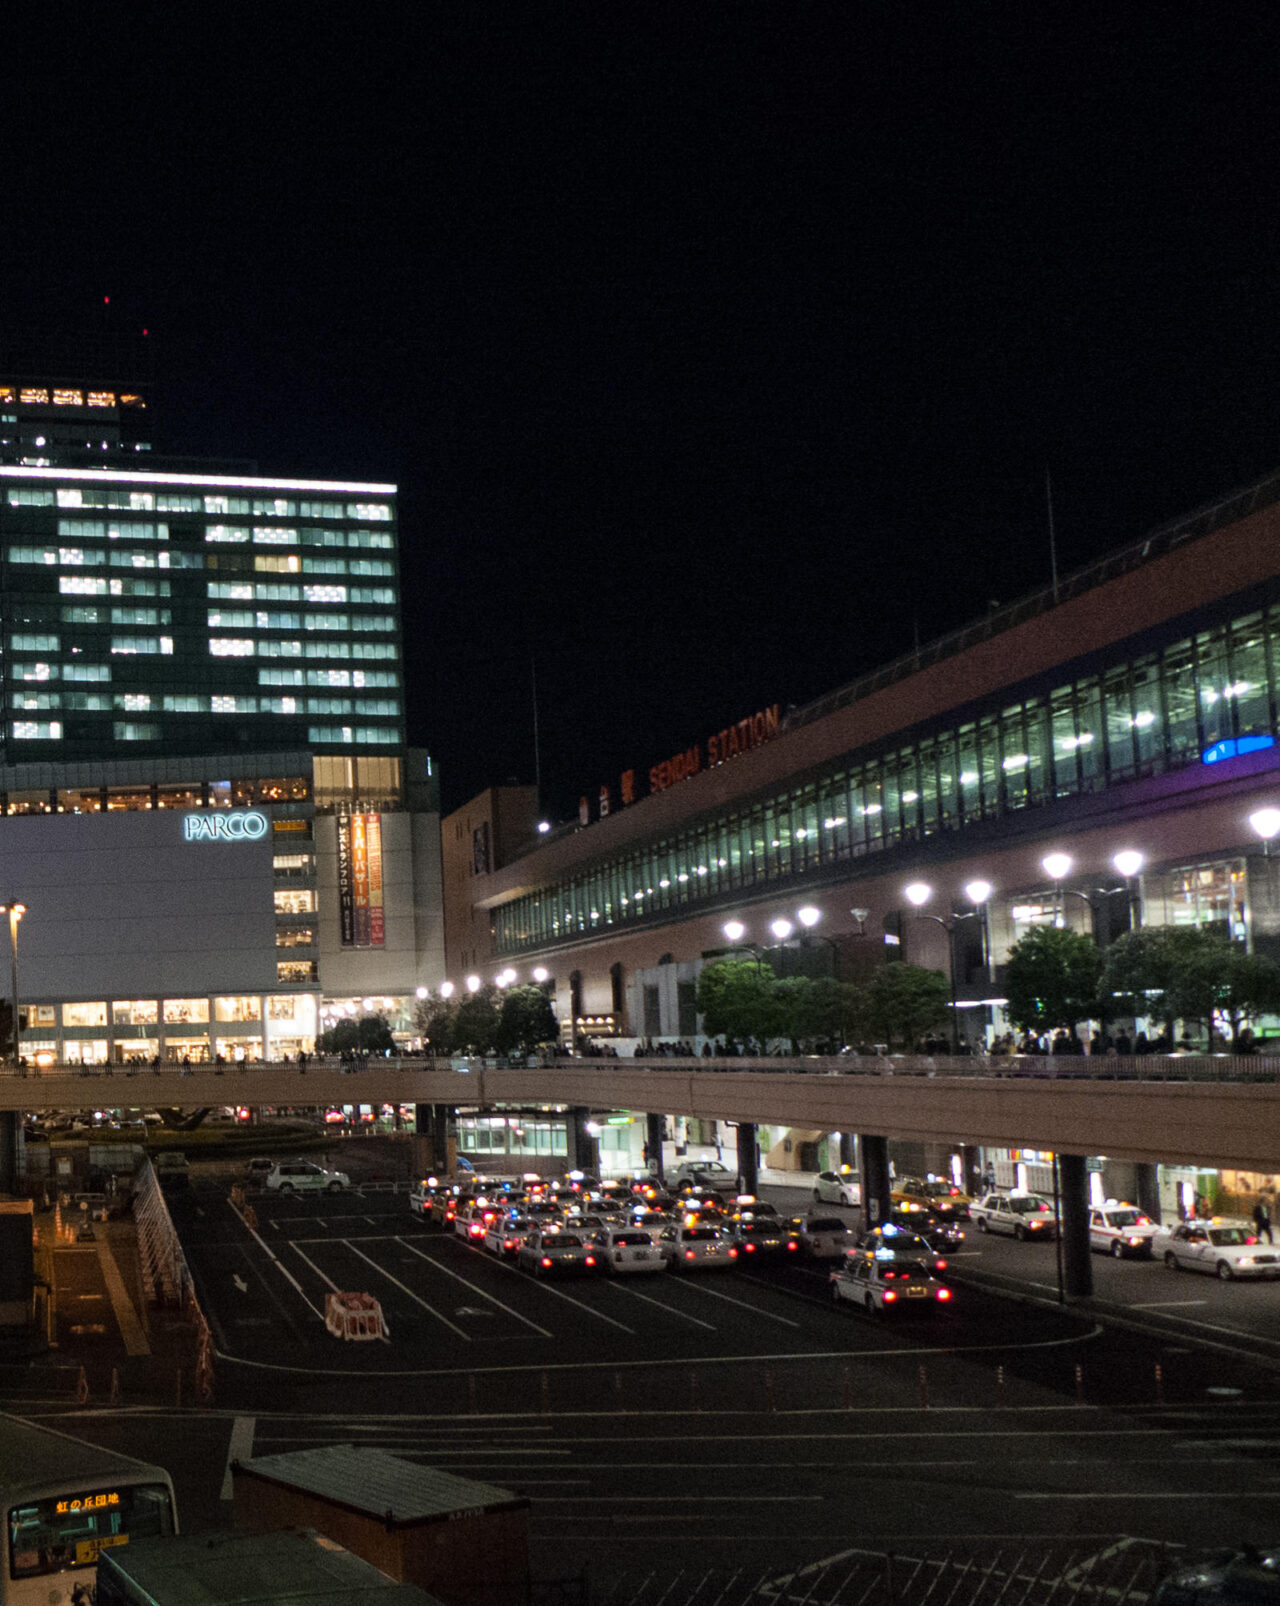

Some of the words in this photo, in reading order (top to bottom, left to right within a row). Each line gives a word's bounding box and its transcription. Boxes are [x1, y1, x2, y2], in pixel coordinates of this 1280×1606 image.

[707, 704, 780, 766] STATION
[185, 812, 267, 840] PARCO
[353, 816, 367, 905] スーパーバザール
[55, 1492, 121, 1515] 虹の丘団地
